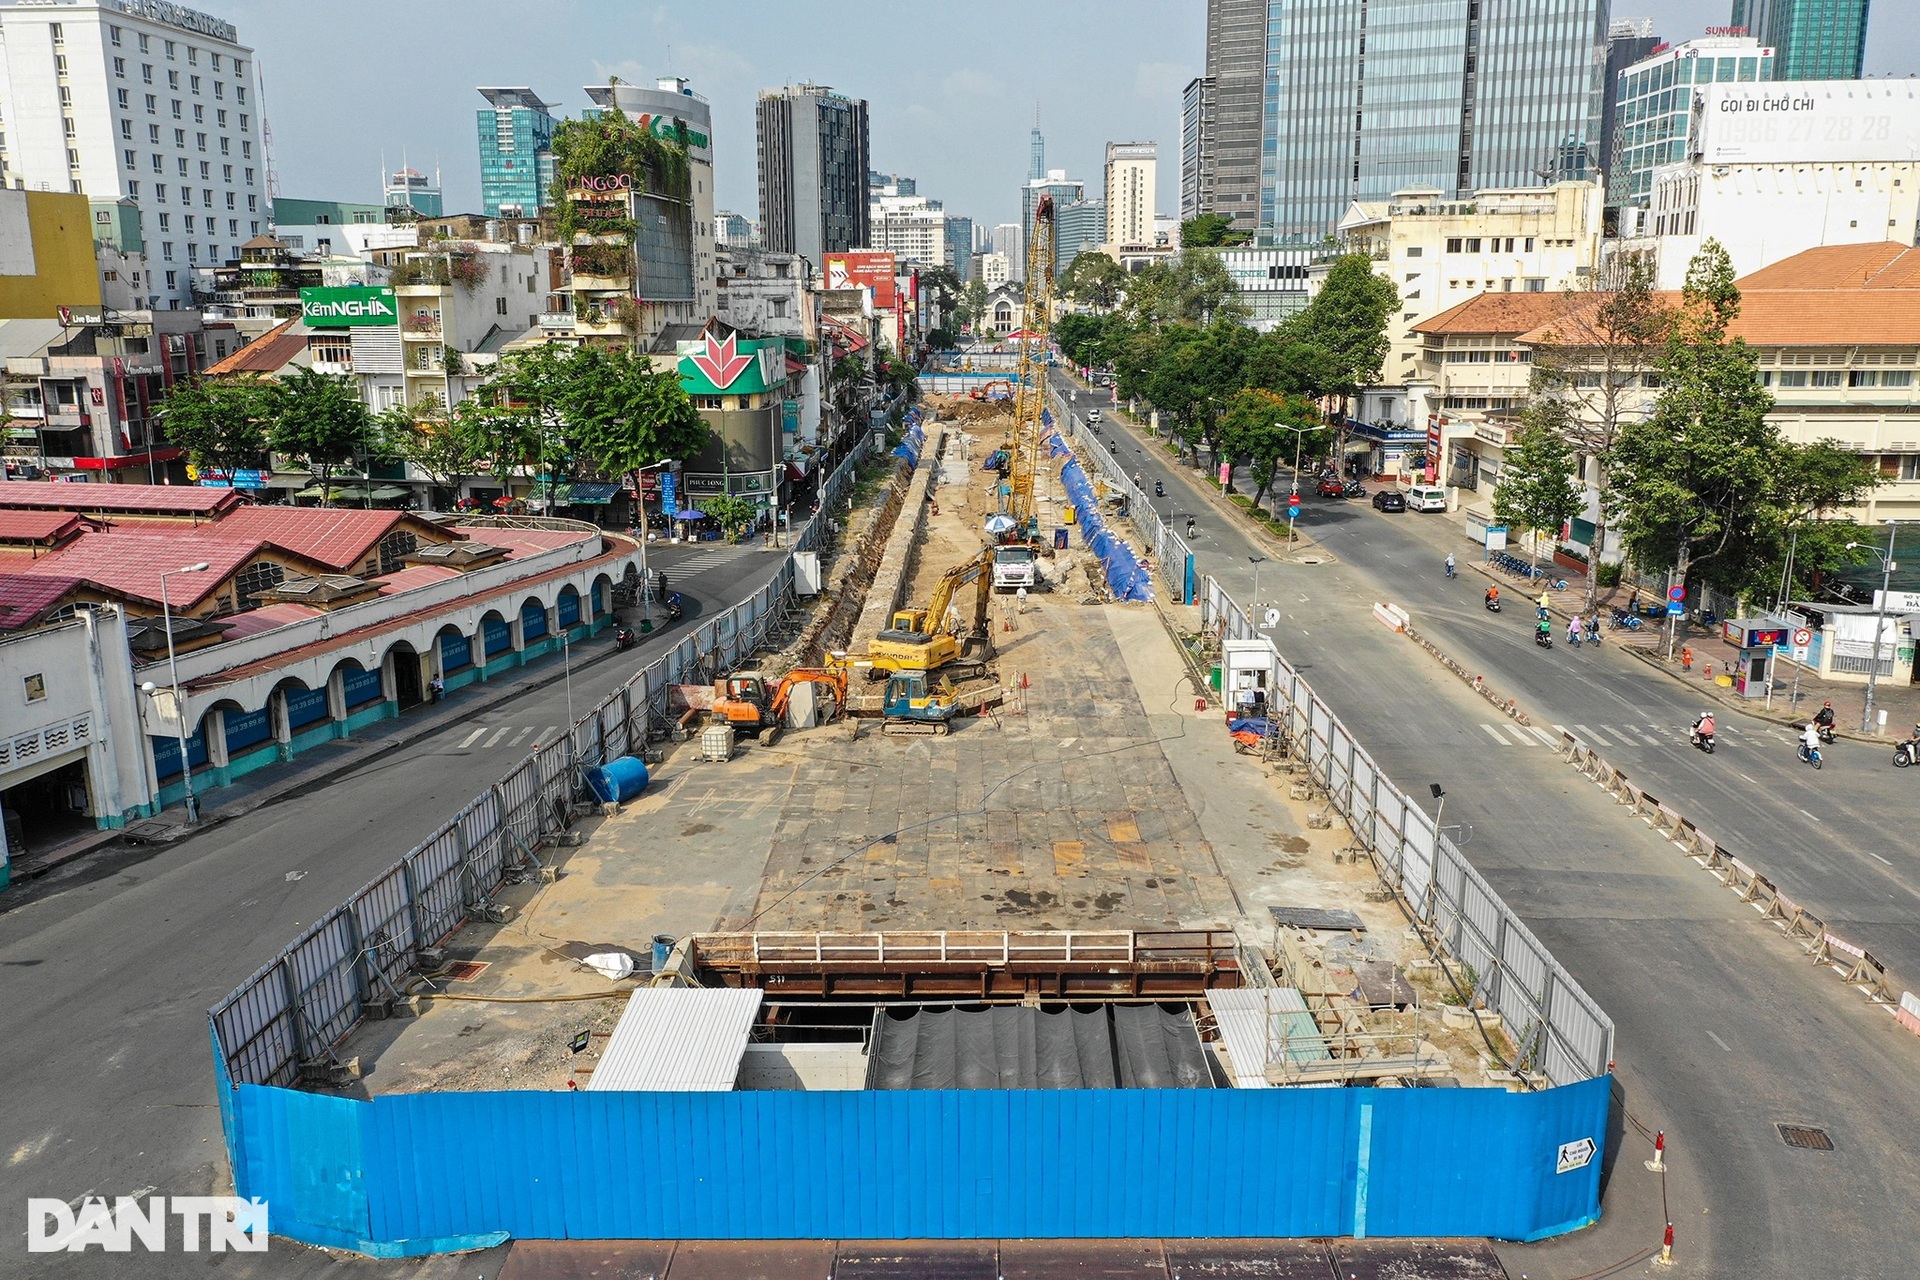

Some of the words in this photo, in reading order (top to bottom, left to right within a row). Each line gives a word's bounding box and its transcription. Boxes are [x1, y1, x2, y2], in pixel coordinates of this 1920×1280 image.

[1705, 26, 1749, 36] SUNWAH
[1721, 99, 1742, 114] GỌI
[1746, 99, 1759, 112] ĐI
[1793, 98, 1815, 111] CHI
[225, 715, 266, 735] 969.39.89.89
